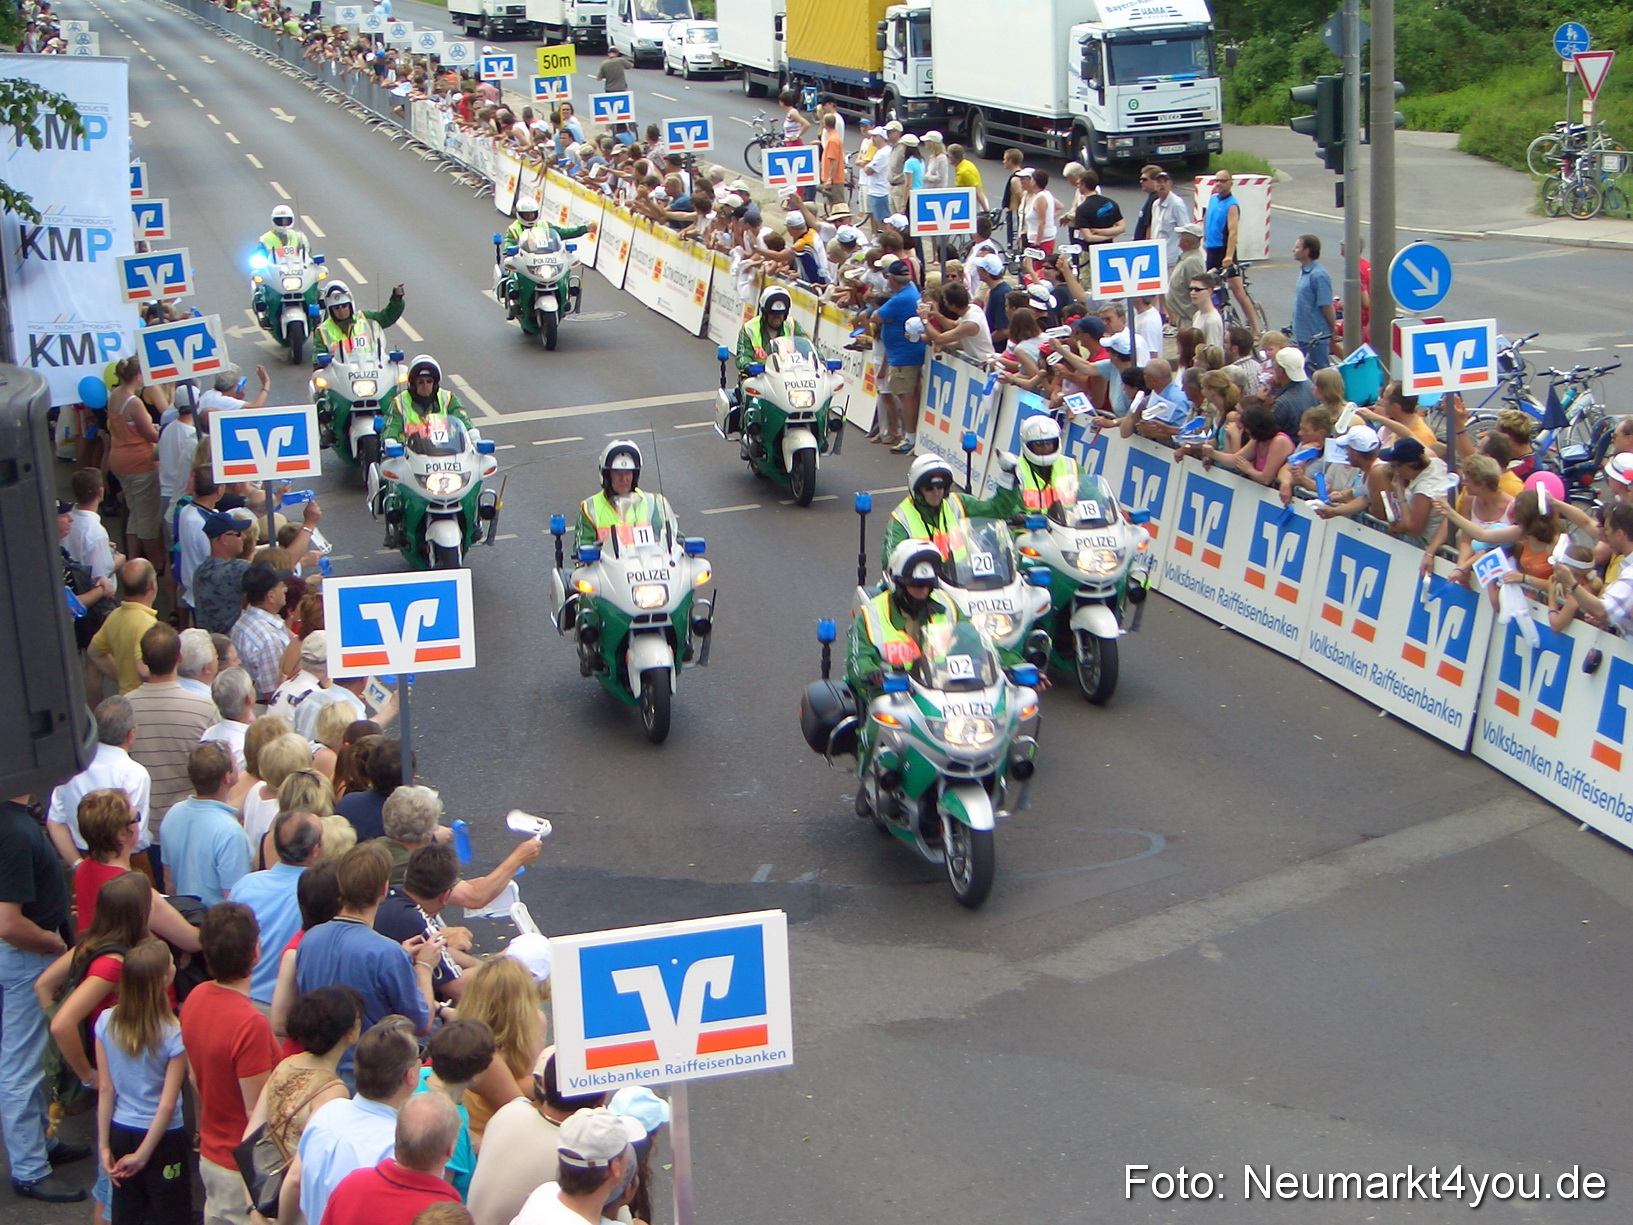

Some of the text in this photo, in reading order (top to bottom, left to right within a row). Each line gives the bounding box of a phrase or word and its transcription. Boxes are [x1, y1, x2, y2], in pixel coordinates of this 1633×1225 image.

[543, 54, 571, 69] 50m
[20, 225, 113, 262] KMP
[284, 247, 294, 255] 08
[355, 337, 365, 347] 10
[29, 332, 122, 368] KMP
[790, 354, 801, 363] 12
[348, 371, 378, 380] POLIZEI
[784, 380, 817, 390] POLIZEI
[434, 431, 445, 440] 17
[425, 462, 462, 473] POLIZEI
[1083, 503, 1096, 516] 18
[637, 529, 649, 543] 11
[1075, 536, 1117, 549] POLIZEI
[975, 556, 992, 571] 20
[626, 569, 671, 584] POLIZEI
[968, 599, 1014, 614] POLIZEI
[1164, 561, 1299, 641] Volksbanken Raiffeisenbanken
[950, 659, 973, 675] 02
[1309, 630, 1463, 729] Volksbanken Raiffeisenbanken
[942, 702, 995, 718] POLIZEI
[1483, 717, 1552, 778] Volksbanken
[569, 1050, 787, 1089] Volksbanken Raiffeisenbanken
